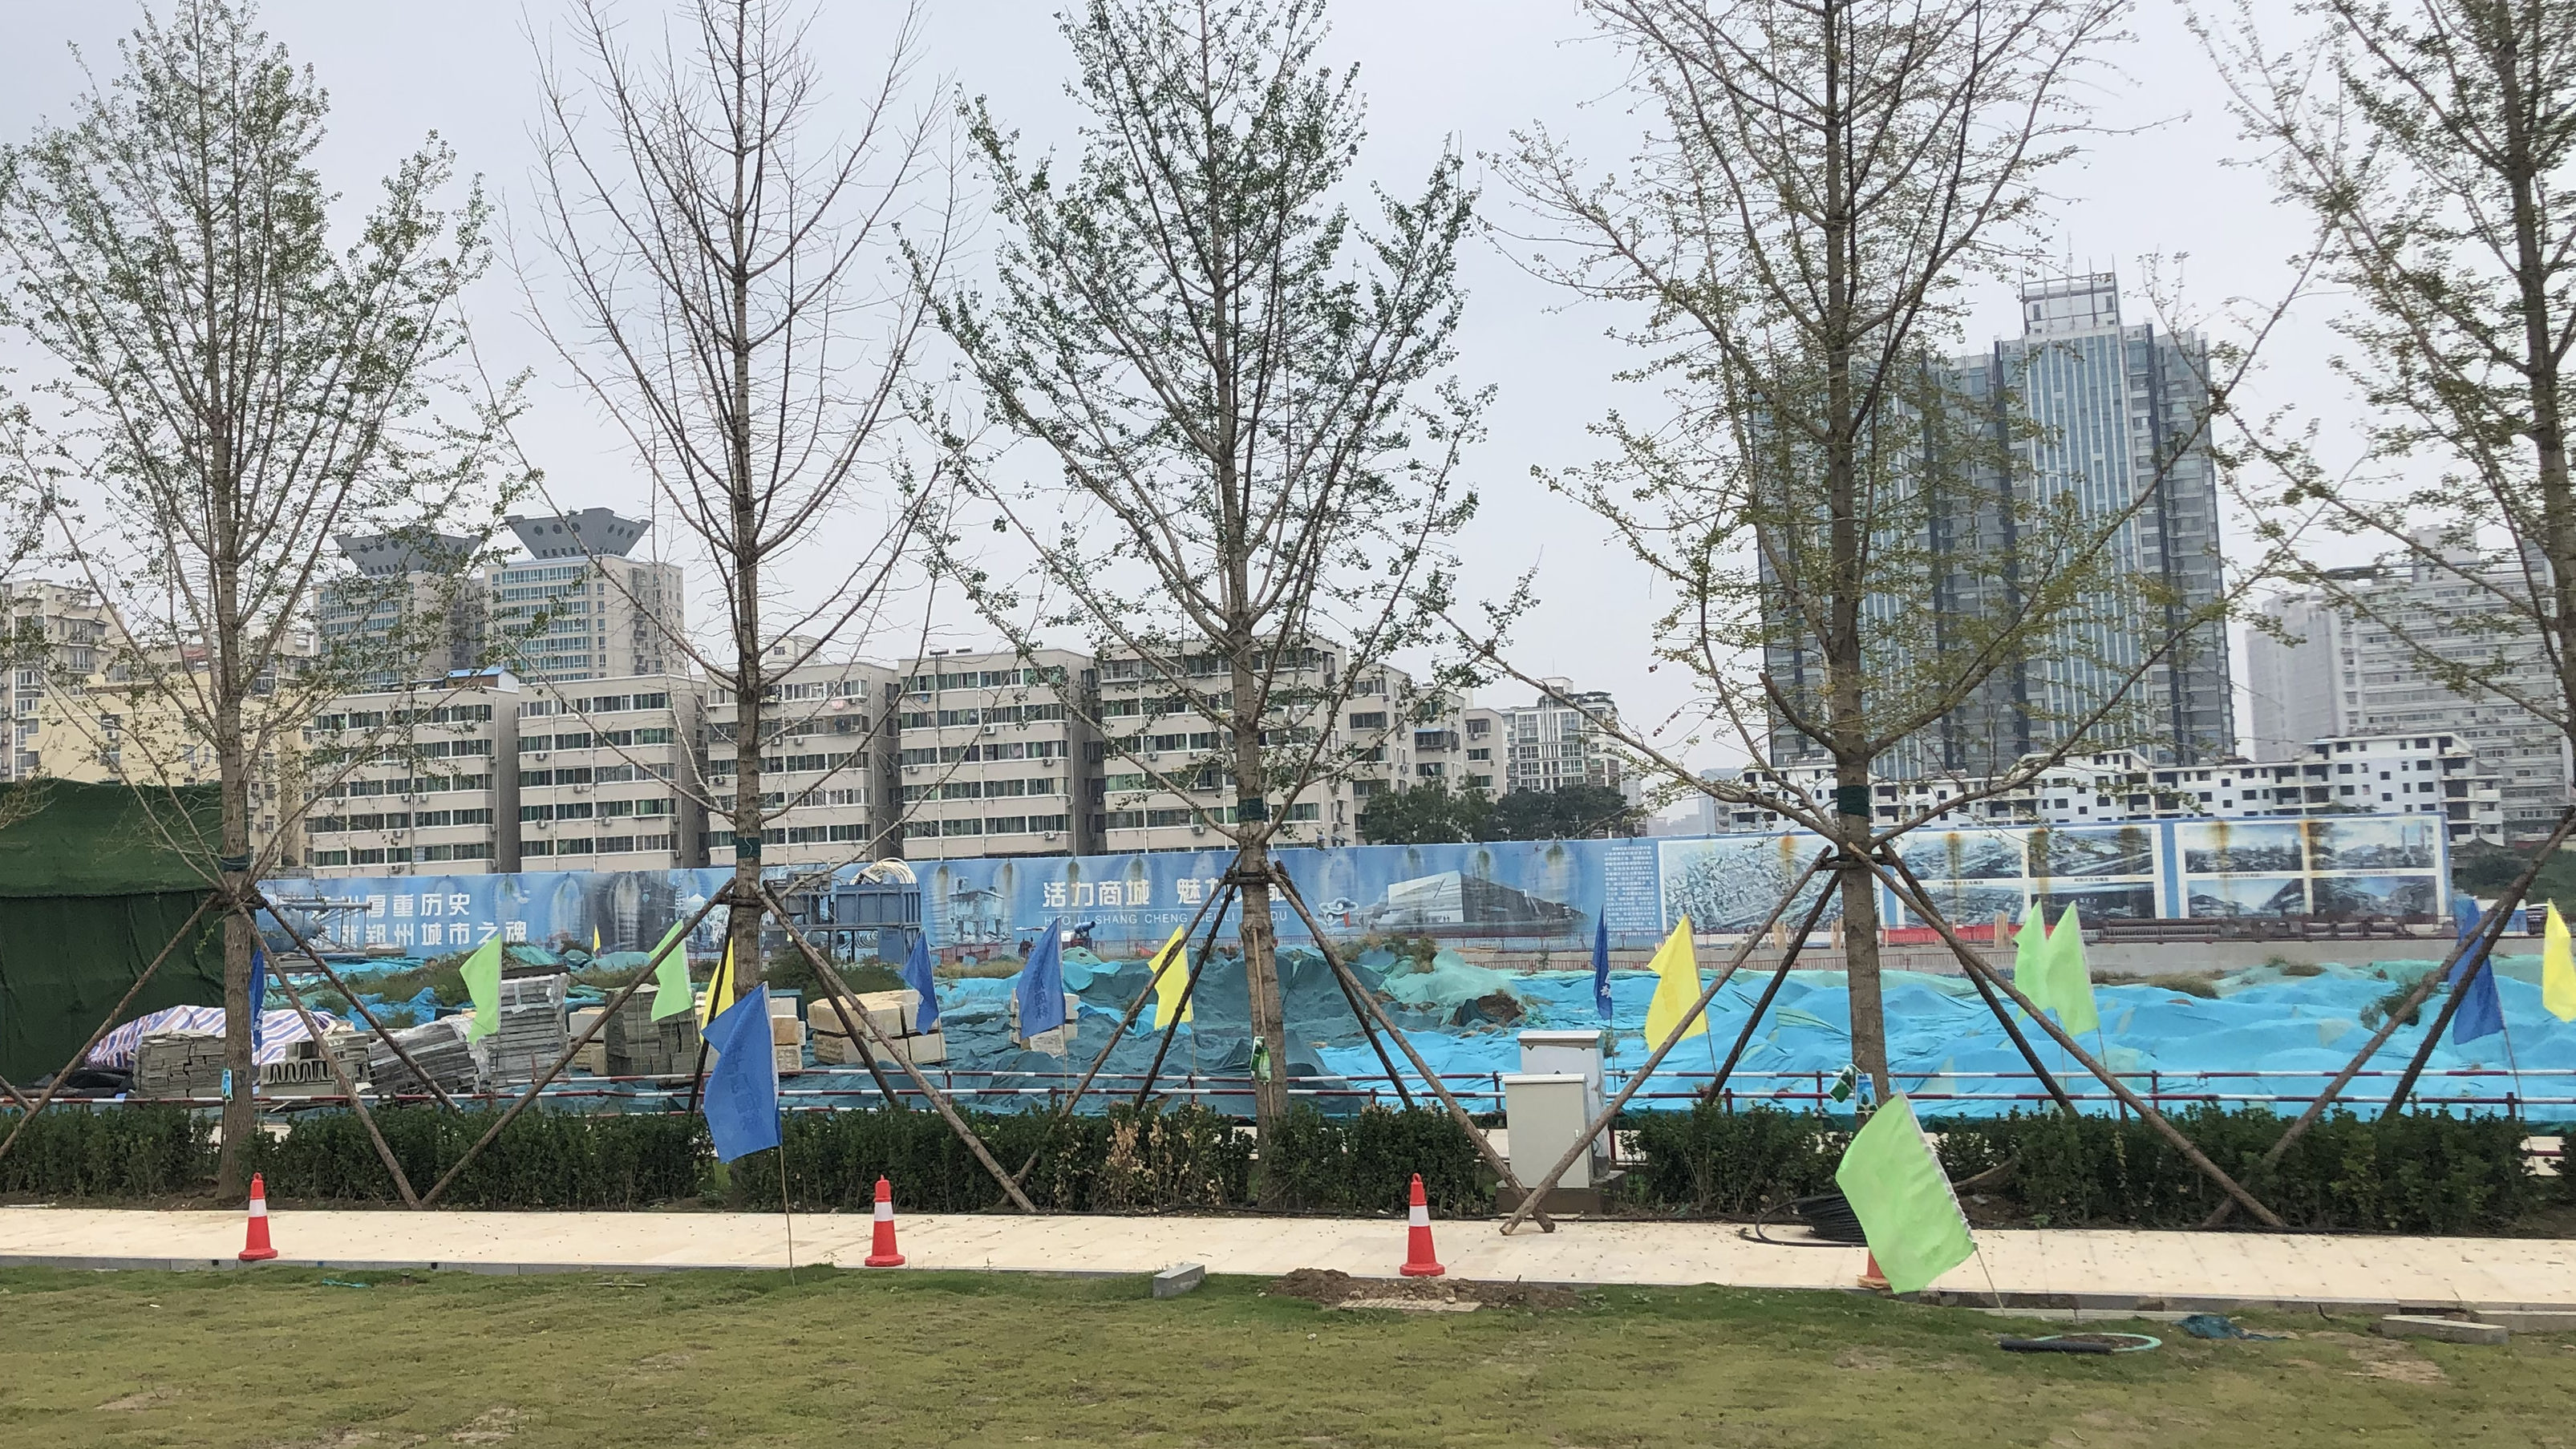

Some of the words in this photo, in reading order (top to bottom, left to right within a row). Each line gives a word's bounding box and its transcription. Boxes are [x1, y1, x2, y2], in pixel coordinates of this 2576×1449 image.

[1043, 879, 1150, 907] 活力商城
[1044, 916, 1071, 925] HO
[1095, 914, 1137, 925] SHANG
[1144, 913, 1188, 923] CHENG
